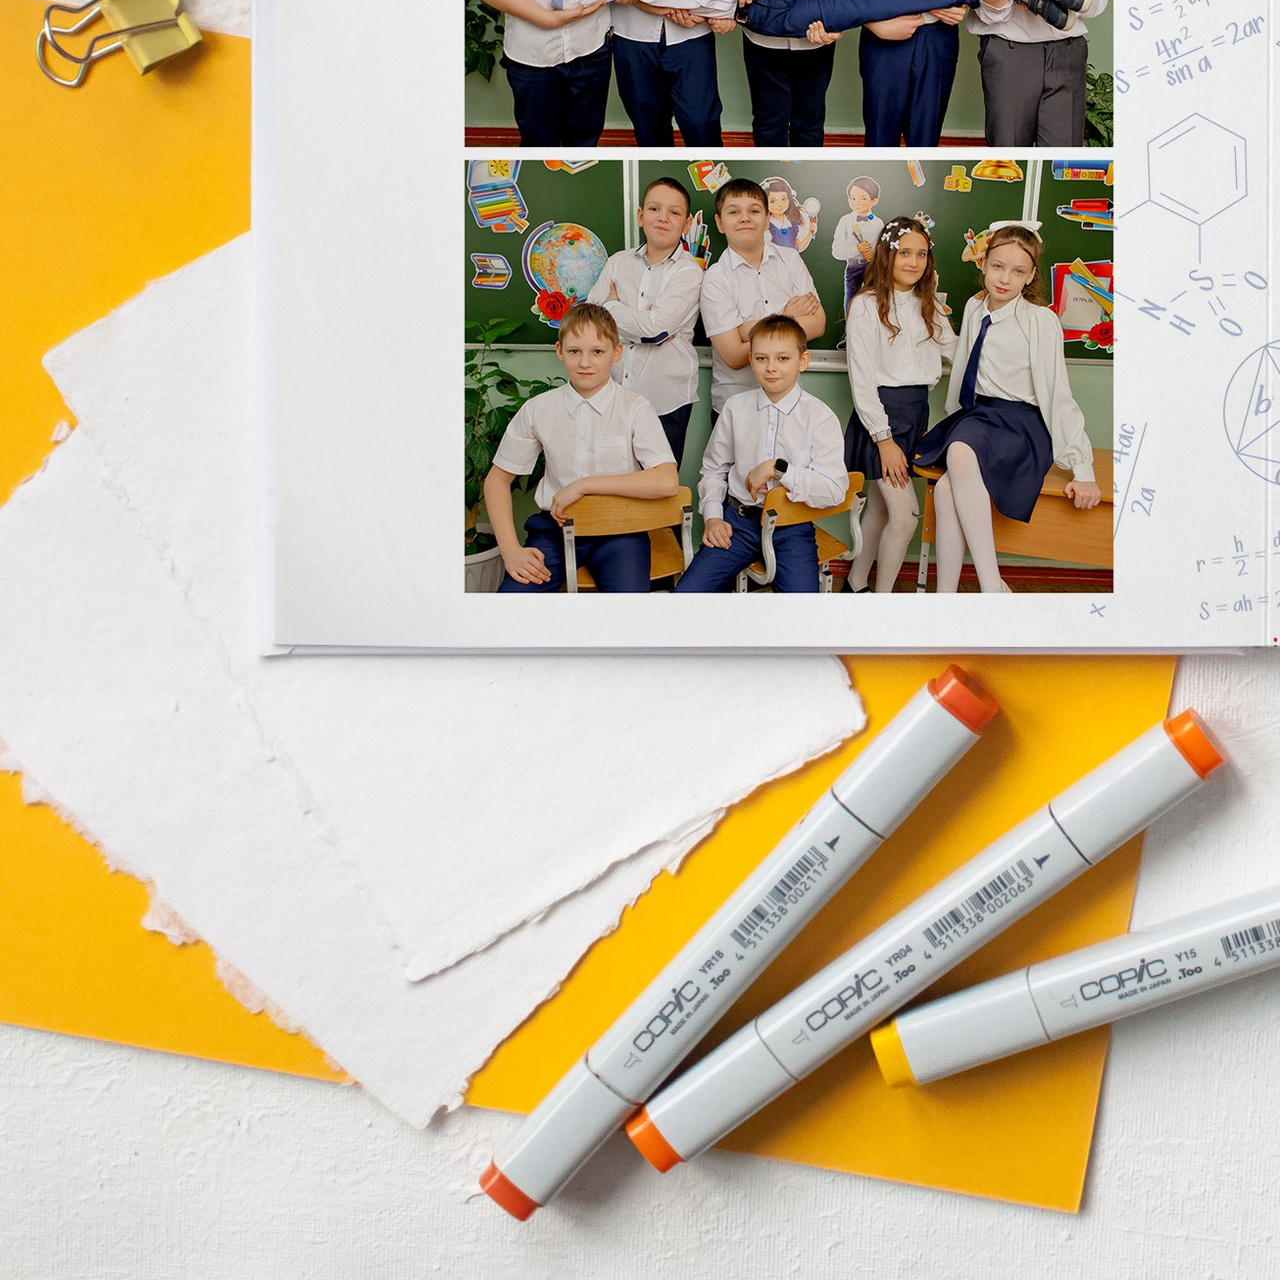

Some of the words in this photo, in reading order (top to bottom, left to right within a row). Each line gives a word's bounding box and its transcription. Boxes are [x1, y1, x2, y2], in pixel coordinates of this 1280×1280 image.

[1127, 6, 1144, 32] S
[1114, 69, 1131, 94] S
[1225, 15, 1265, 45] 2ar
[1166, 63, 1194, 87] sin
[1188, 269, 1215, 291] S
[1254, 384, 1272, 416] b
[1236, 559, 1249, 577] 2
[1198, 601, 1211, 621] S
[1232, 593, 1254, 613] ah
[786, 861, 829, 905] 002117
[986, 877, 1034, 915] 002063
[698, 948, 725, 977] YR18
[884, 943, 914, 967] YR04
[1174, 947, 1198, 963] Y15
[1079, 958, 1168, 1002] COPIC
[1117, 989, 1139, 1001] MADE
[1148, 977, 1173, 991] JAPAN
[669, 1018, 687, 1036] MADE
[691, 993, 710, 1014] JAPAN
[805, 968, 883, 1032] COPIC
[843, 1006, 863, 1021] MADE
[869, 984, 891, 1004] JAPAN
[632, 979, 700, 1052] COPIC
